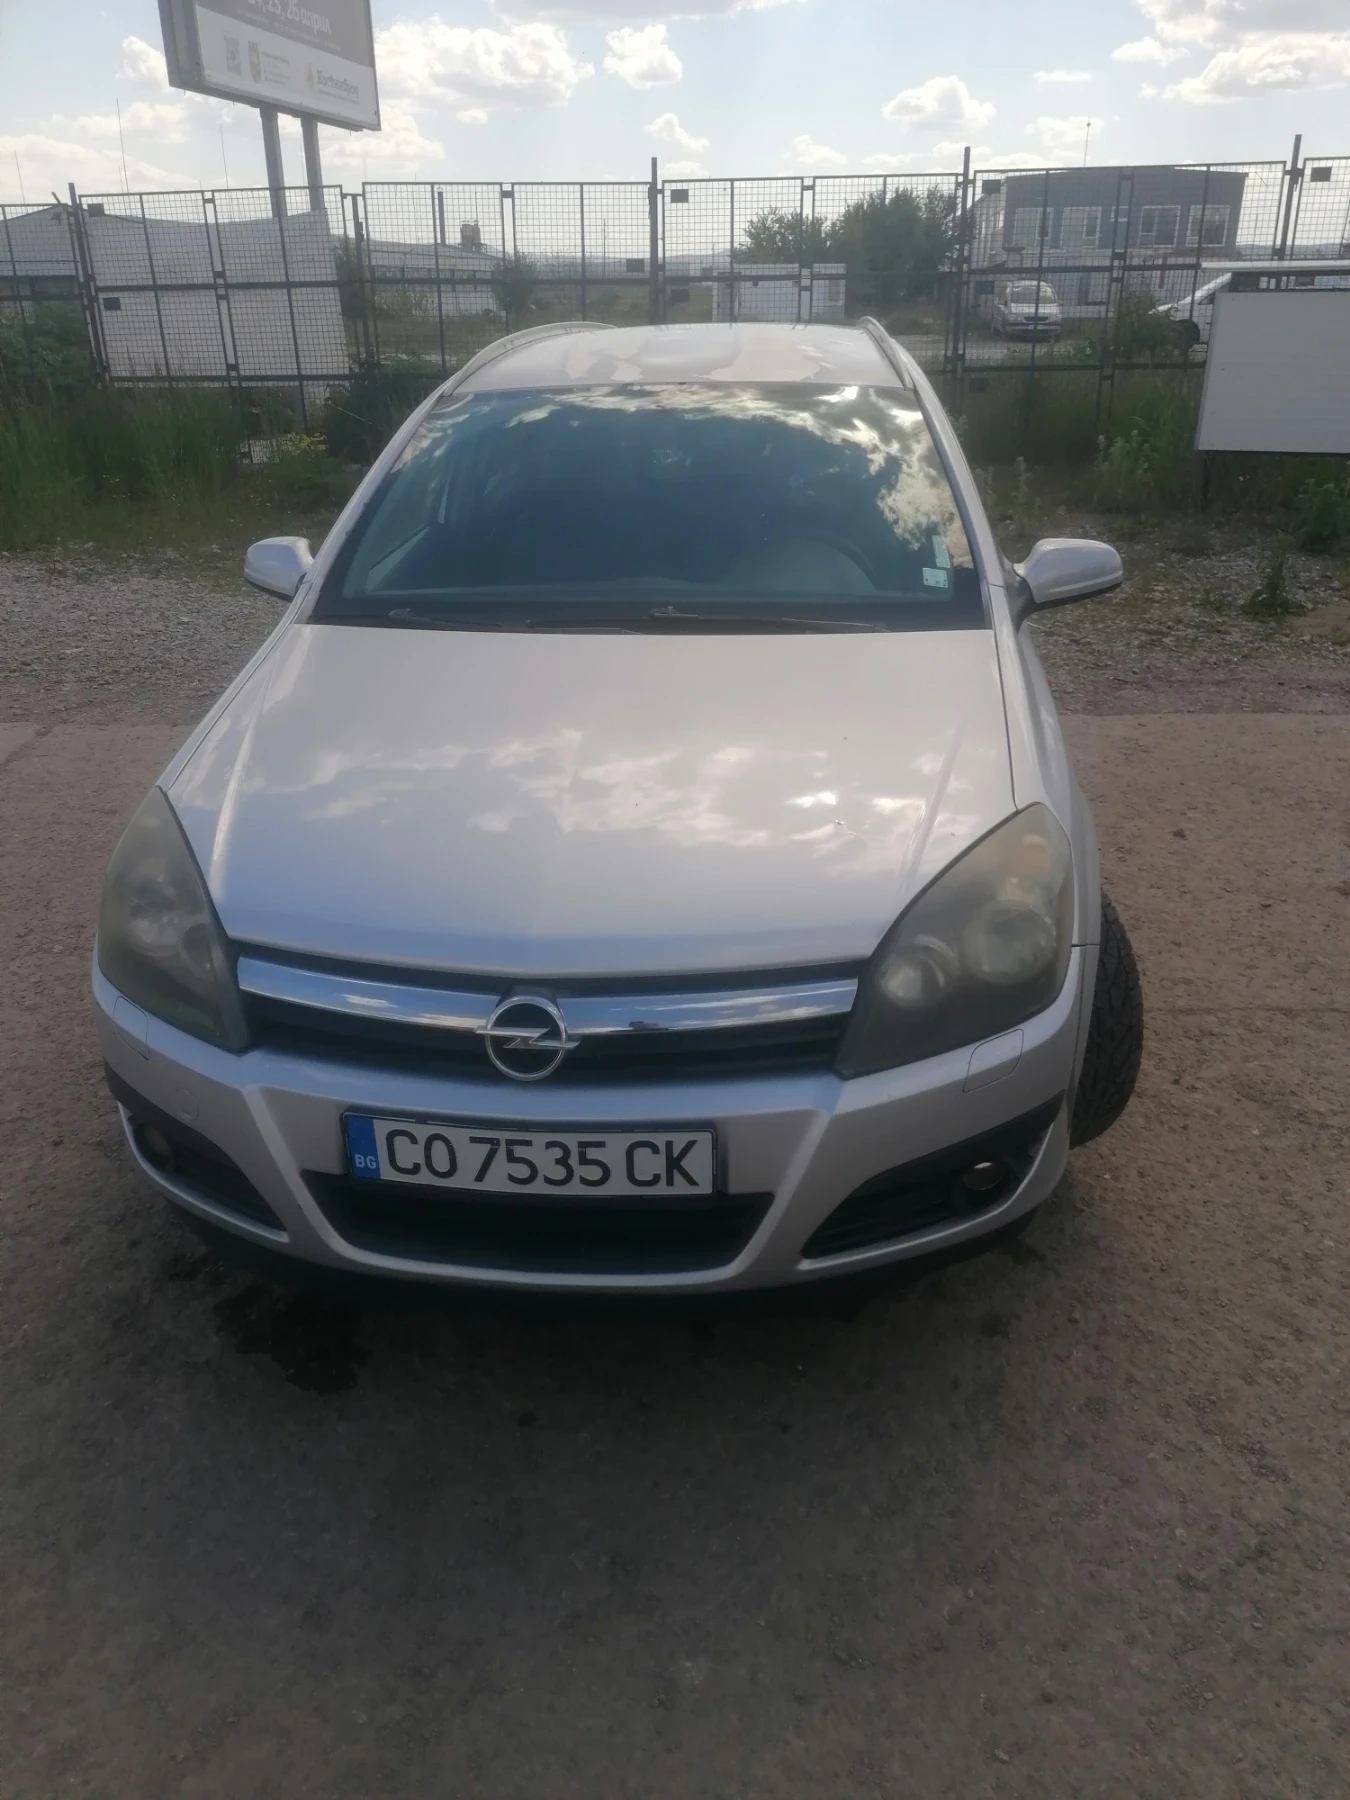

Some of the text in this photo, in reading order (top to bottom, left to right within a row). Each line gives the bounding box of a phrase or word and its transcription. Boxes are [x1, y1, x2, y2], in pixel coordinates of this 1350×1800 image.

[354, 1128, 699, 1187] BG CO 7535 CK
